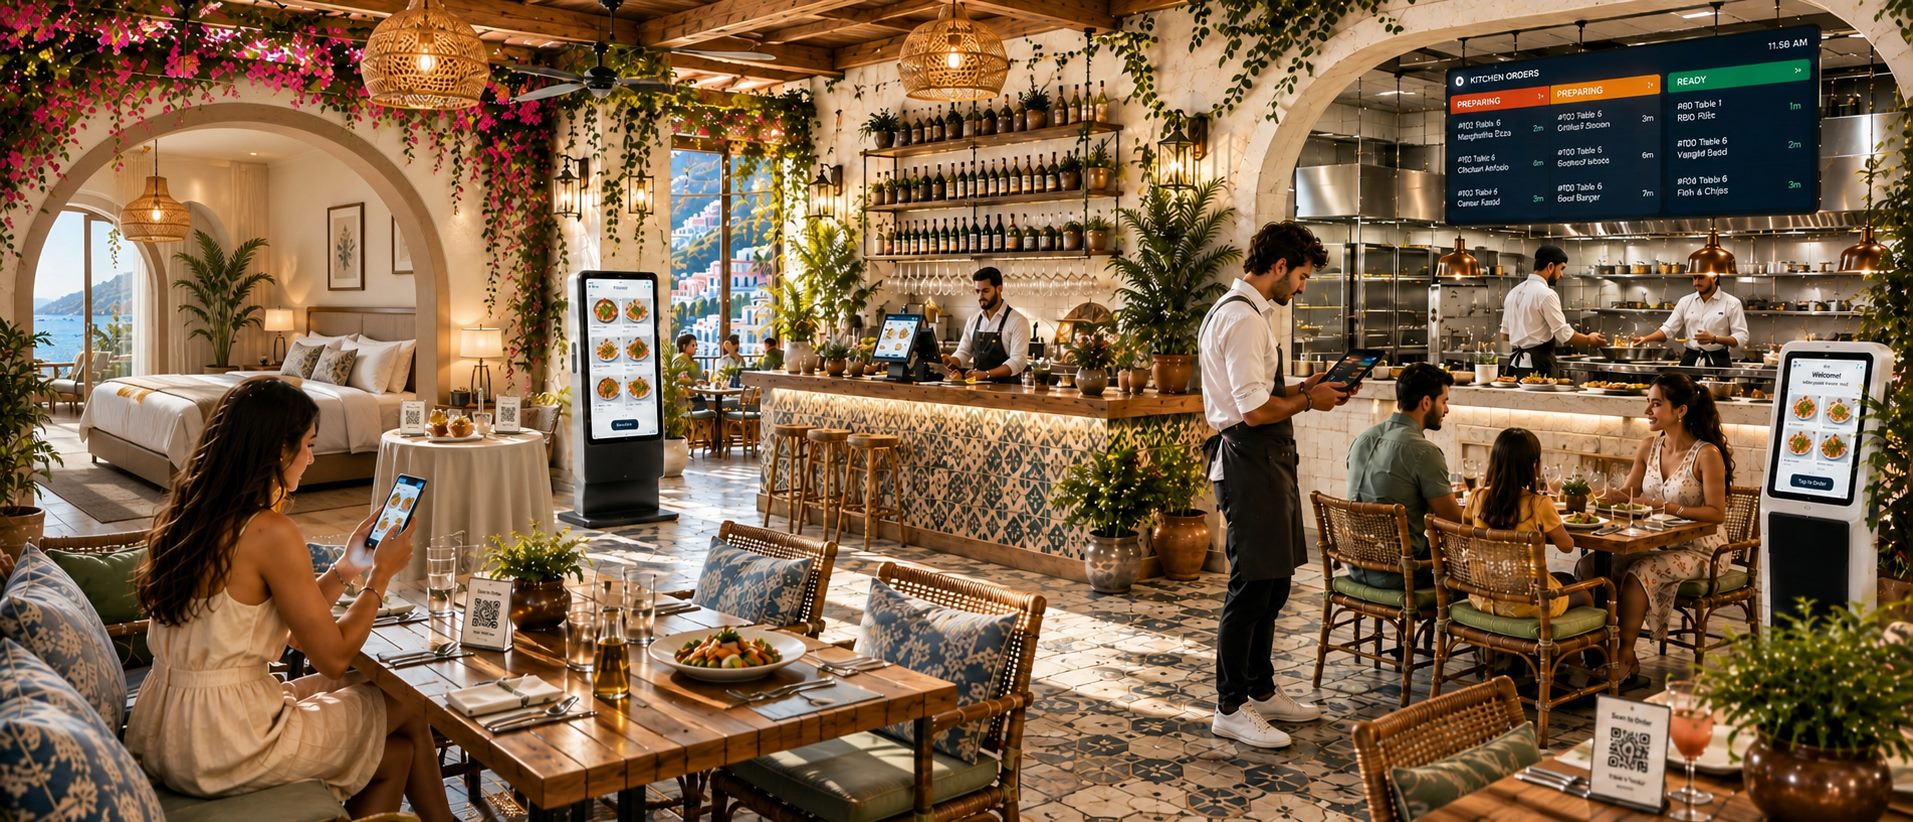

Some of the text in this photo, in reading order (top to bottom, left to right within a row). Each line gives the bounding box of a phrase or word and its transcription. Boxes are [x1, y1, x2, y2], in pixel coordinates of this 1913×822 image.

[1793, 38, 1808, 48] AM
[1470, 69, 1540, 84] KITCHEN ORDERS
[1677, 75, 1707, 86] READY
[1557, 85, 1604, 98] PREPARING
[1457, 97, 1501, 108] PREPARING
[1694, 100, 1716, 109] Table
[1789, 102, 1801, 110] 1m
[1641, 114, 1654, 122] 3m
[1532, 124, 1544, 132] 2m
[1721, 136, 1728, 145] 6
[1788, 140, 1801, 149] 2m
[1641, 151, 1654, 159] 6m
[1721, 174, 1728, 183] 6
[1597, 182, 1603, 190] 6
[1788, 180, 1801, 189] 3m
[1532, 194, 1544, 203] 3m
[1812, 371, 1842, 379] Welcome!
